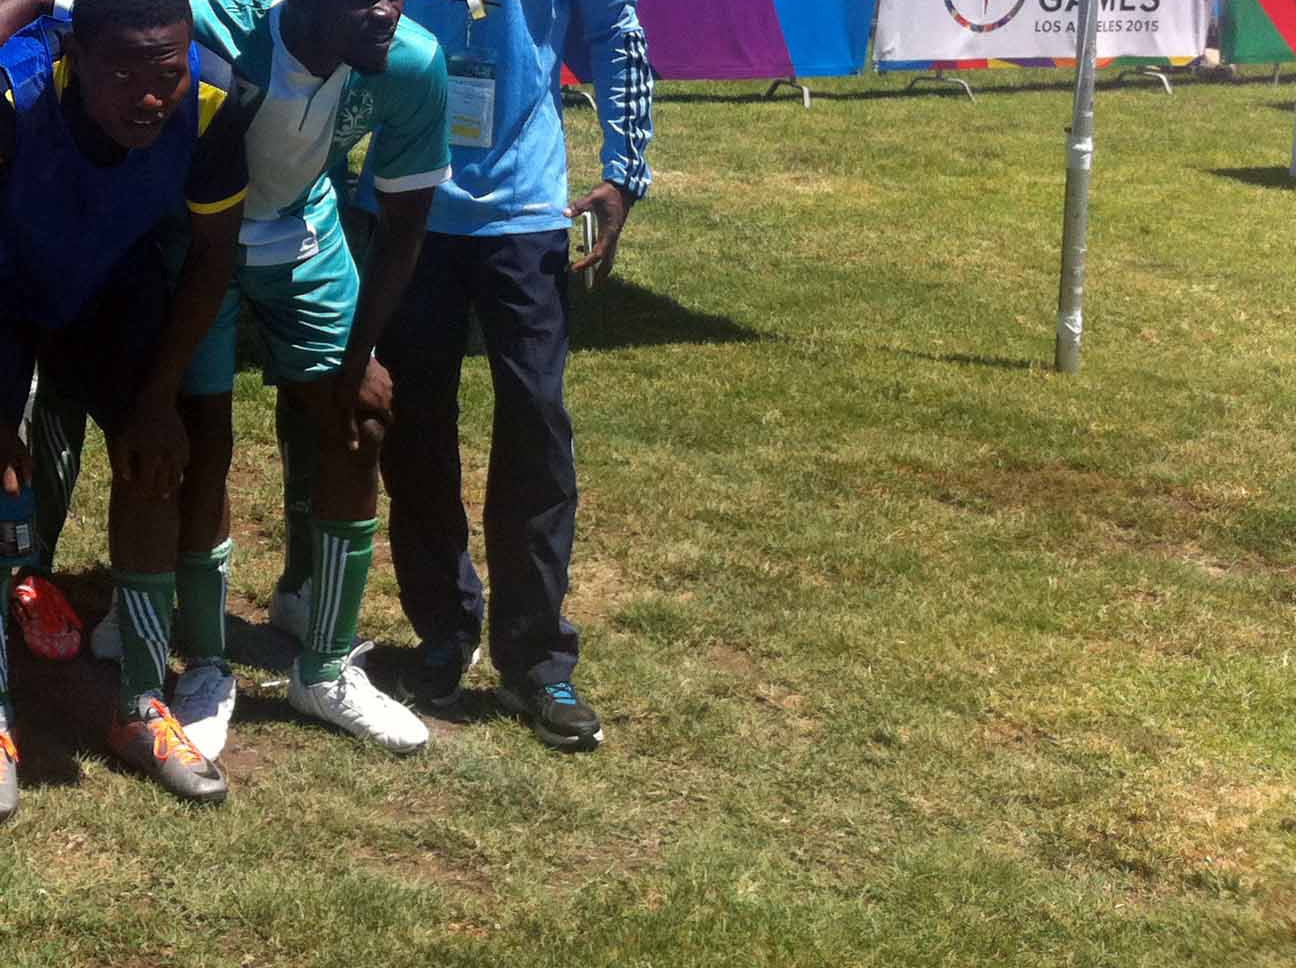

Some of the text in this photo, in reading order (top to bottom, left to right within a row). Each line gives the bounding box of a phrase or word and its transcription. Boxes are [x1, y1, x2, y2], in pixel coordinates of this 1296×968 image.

[1035, 20, 1159, 33] LOS AELES 2015
